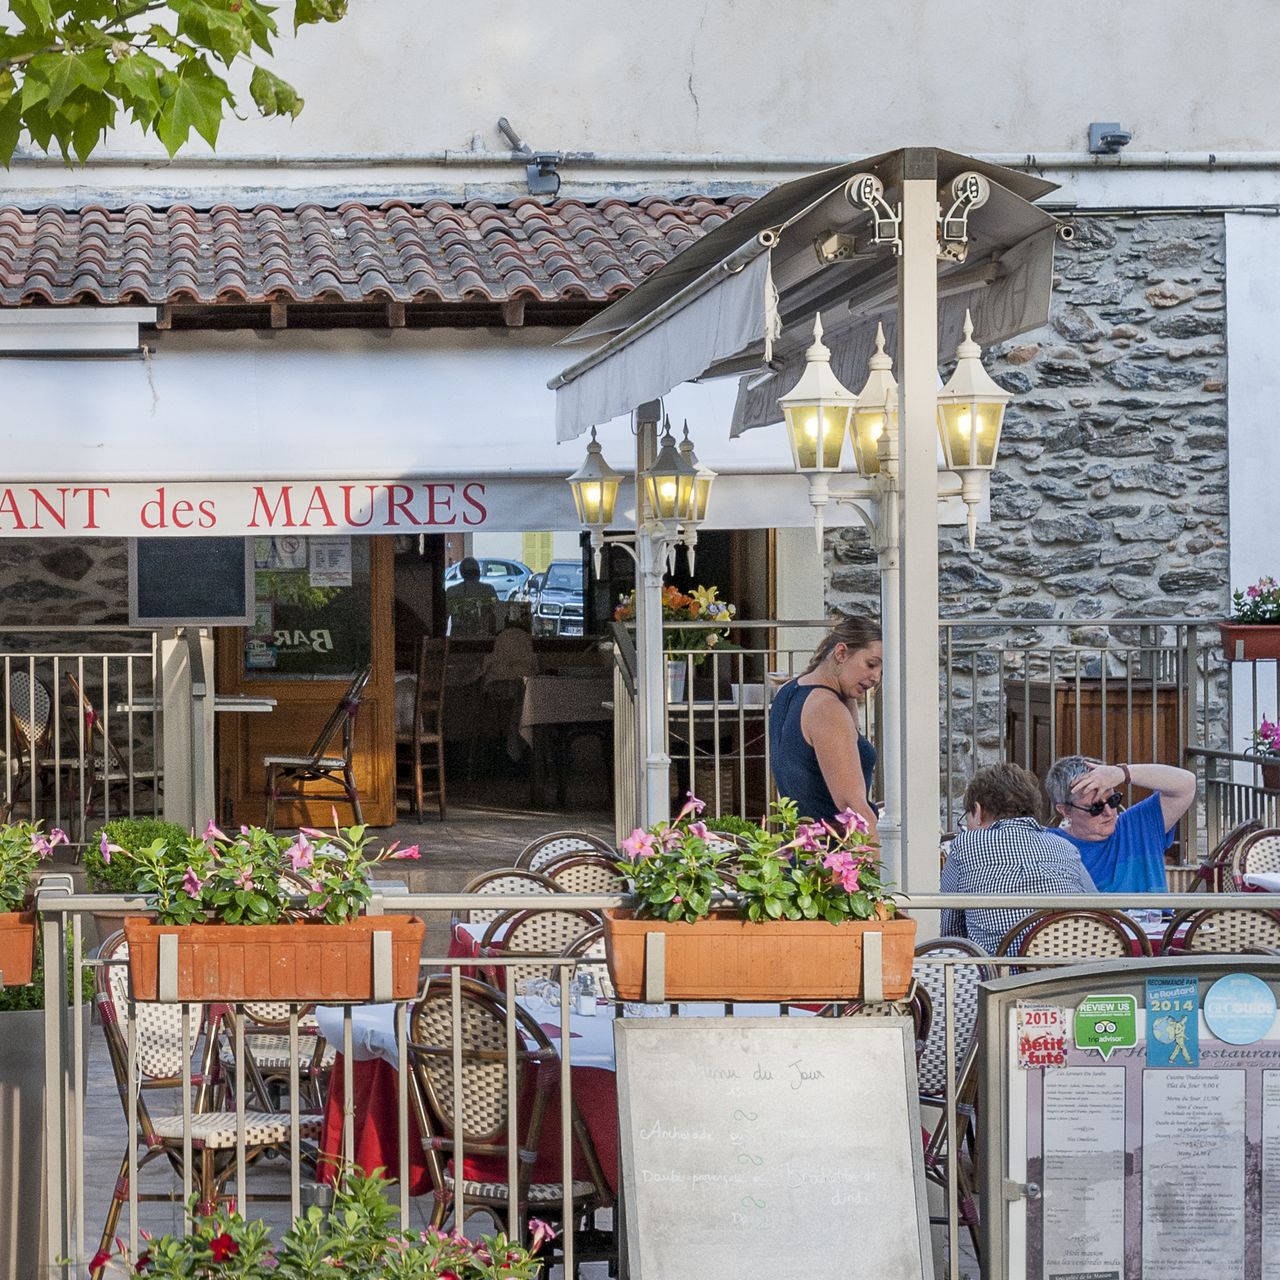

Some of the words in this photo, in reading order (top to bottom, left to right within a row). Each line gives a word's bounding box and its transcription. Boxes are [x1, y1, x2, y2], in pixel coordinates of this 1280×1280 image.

[139, 486, 218, 529] des
[246, 482, 488, 528] MAURES
[1149, 991, 1159, 1000] Le
[1160, 986, 1195, 999] Routard
[1080, 1003, 1115, 1012] REVIEW
[1117, 1003, 1130, 1012] US
[1151, 1000, 1194, 1012] 2014
[1025, 1012, 1058, 1025] 2015
[1021, 1036, 1064, 1056] petit
[1088, 1036, 1123, 1044] tripadvisor
[1028, 1051, 1065, 1065] futé
[753, 1063, 773, 1081] du
[788, 1058, 825, 1090] Jour
